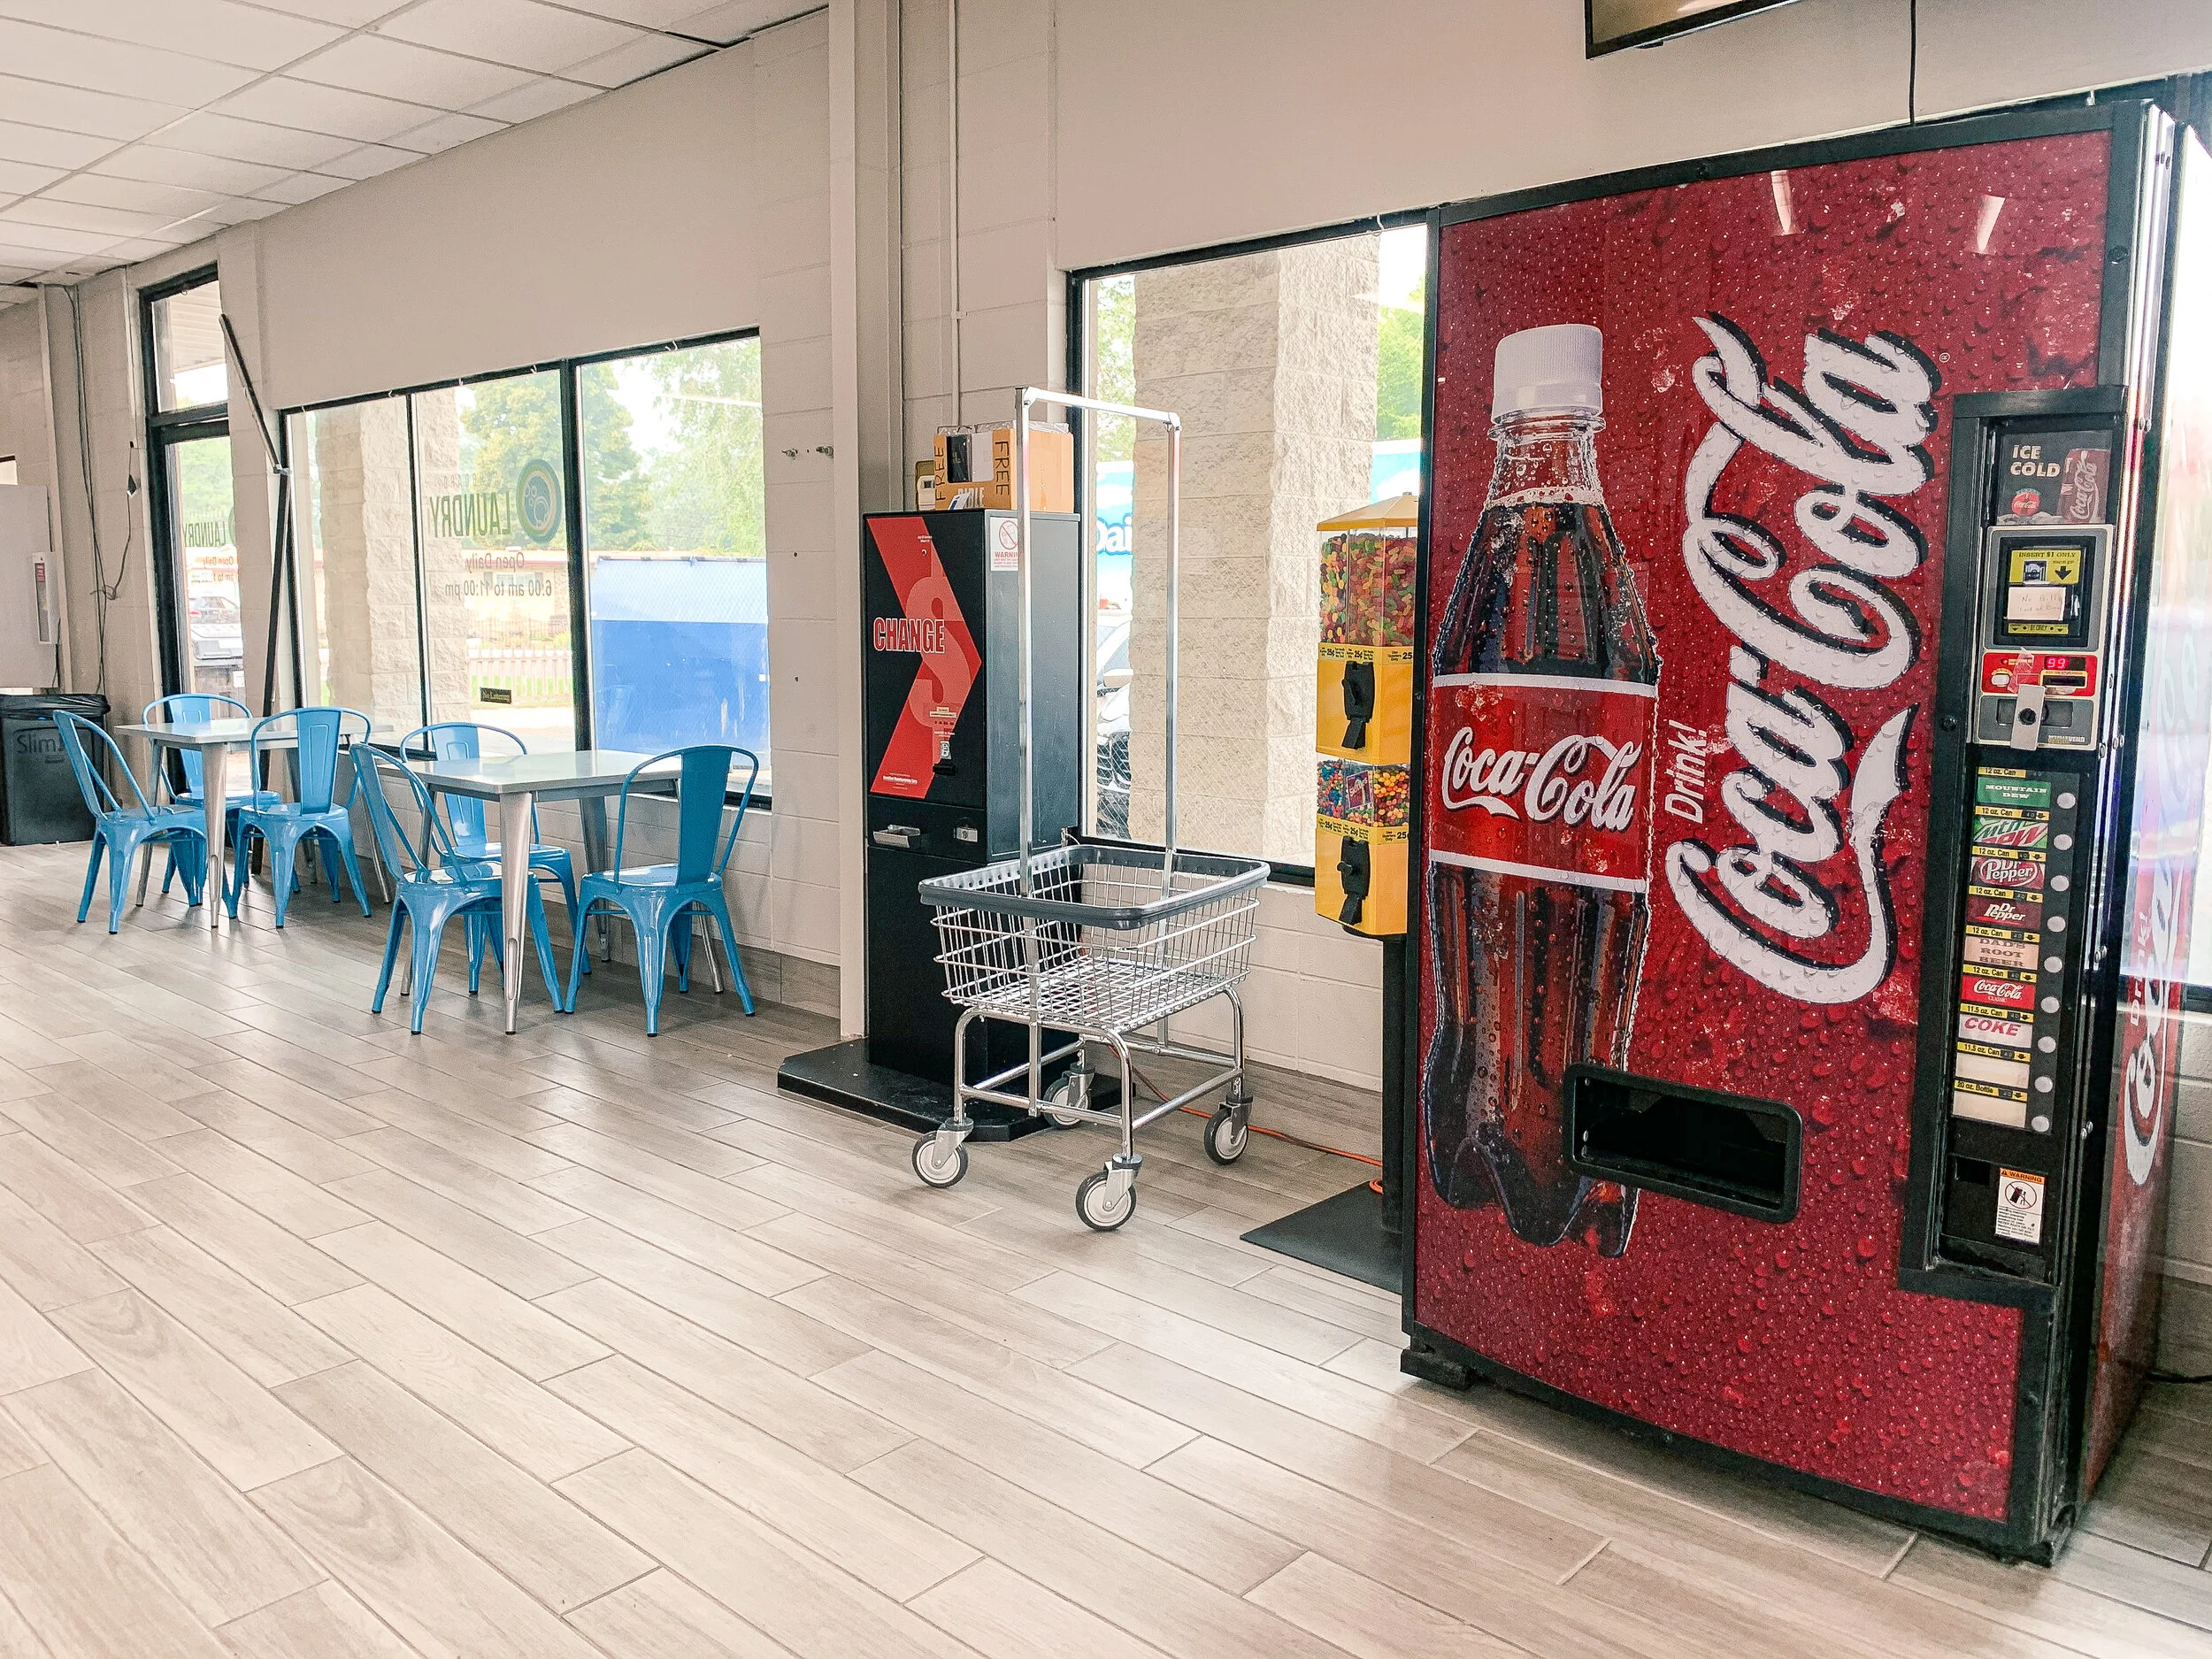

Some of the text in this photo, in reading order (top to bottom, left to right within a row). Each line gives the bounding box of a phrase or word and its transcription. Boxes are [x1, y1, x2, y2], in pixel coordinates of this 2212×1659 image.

[2012, 444, 2042, 459] ICE
[933, 445, 947, 502] FREE
[995, 441, 1010, 496] FREE
[2010, 461, 2061, 477] COLD
[2070, 450, 2100, 520] Coca-Cola
[2013, 500, 2039, 510] Coca-Cola
[873, 618, 945, 654] CHANGE
[1666, 312, 1941, 1005] Coca-Cola
[17, 733, 56, 754] Slim
[1442, 726, 1643, 832] Coca-Cola
[1664, 718, 1708, 825] Drink!
[1985, 785, 2047, 794] MOUNTAIN
[1985, 859, 2033, 882] Pepper
[2001, 859, 2021, 869] Dr
[1993, 888, 2006, 897] Can
[1984, 903, 2026, 921] Pepper
[1999, 902, 2016, 912] Dr
[1978, 938, 2025, 949] DAD'S
[1980, 948, 2024, 957] ROOT
[1978, 956, 2024, 967] BEER
[1973, 979, 2024, 999] Coca-Cola
[1991, 1008, 2002, 1017] Can
[1964, 1018, 2022, 1037] COKE
[1975, 1085, 1993, 1094] Bottle
[2008, 1171, 2042, 1183] WARNING
